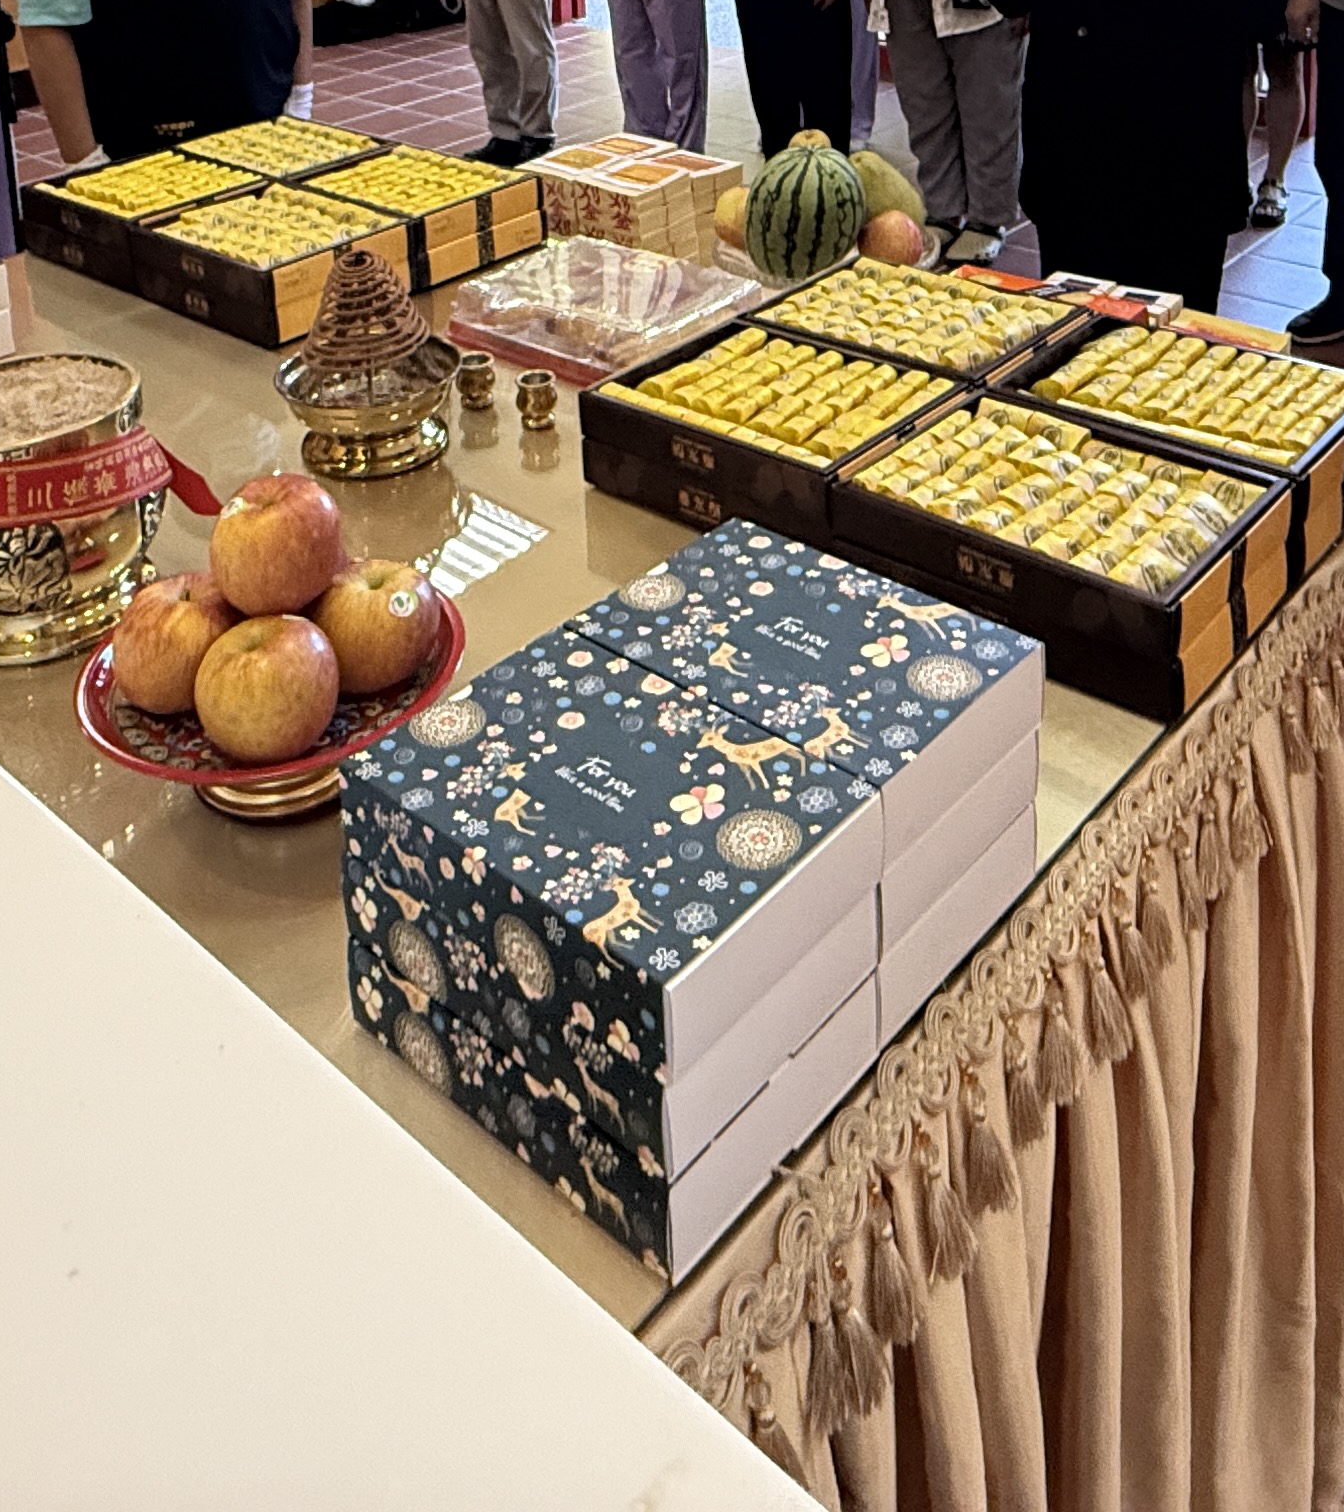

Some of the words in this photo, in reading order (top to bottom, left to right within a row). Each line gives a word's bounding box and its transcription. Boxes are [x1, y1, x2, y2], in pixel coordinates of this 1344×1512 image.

[773, 616, 804, 634] For
[800, 631, 830, 649] you
[576, 754, 612, 778] For
[603, 776, 637, 798] you
